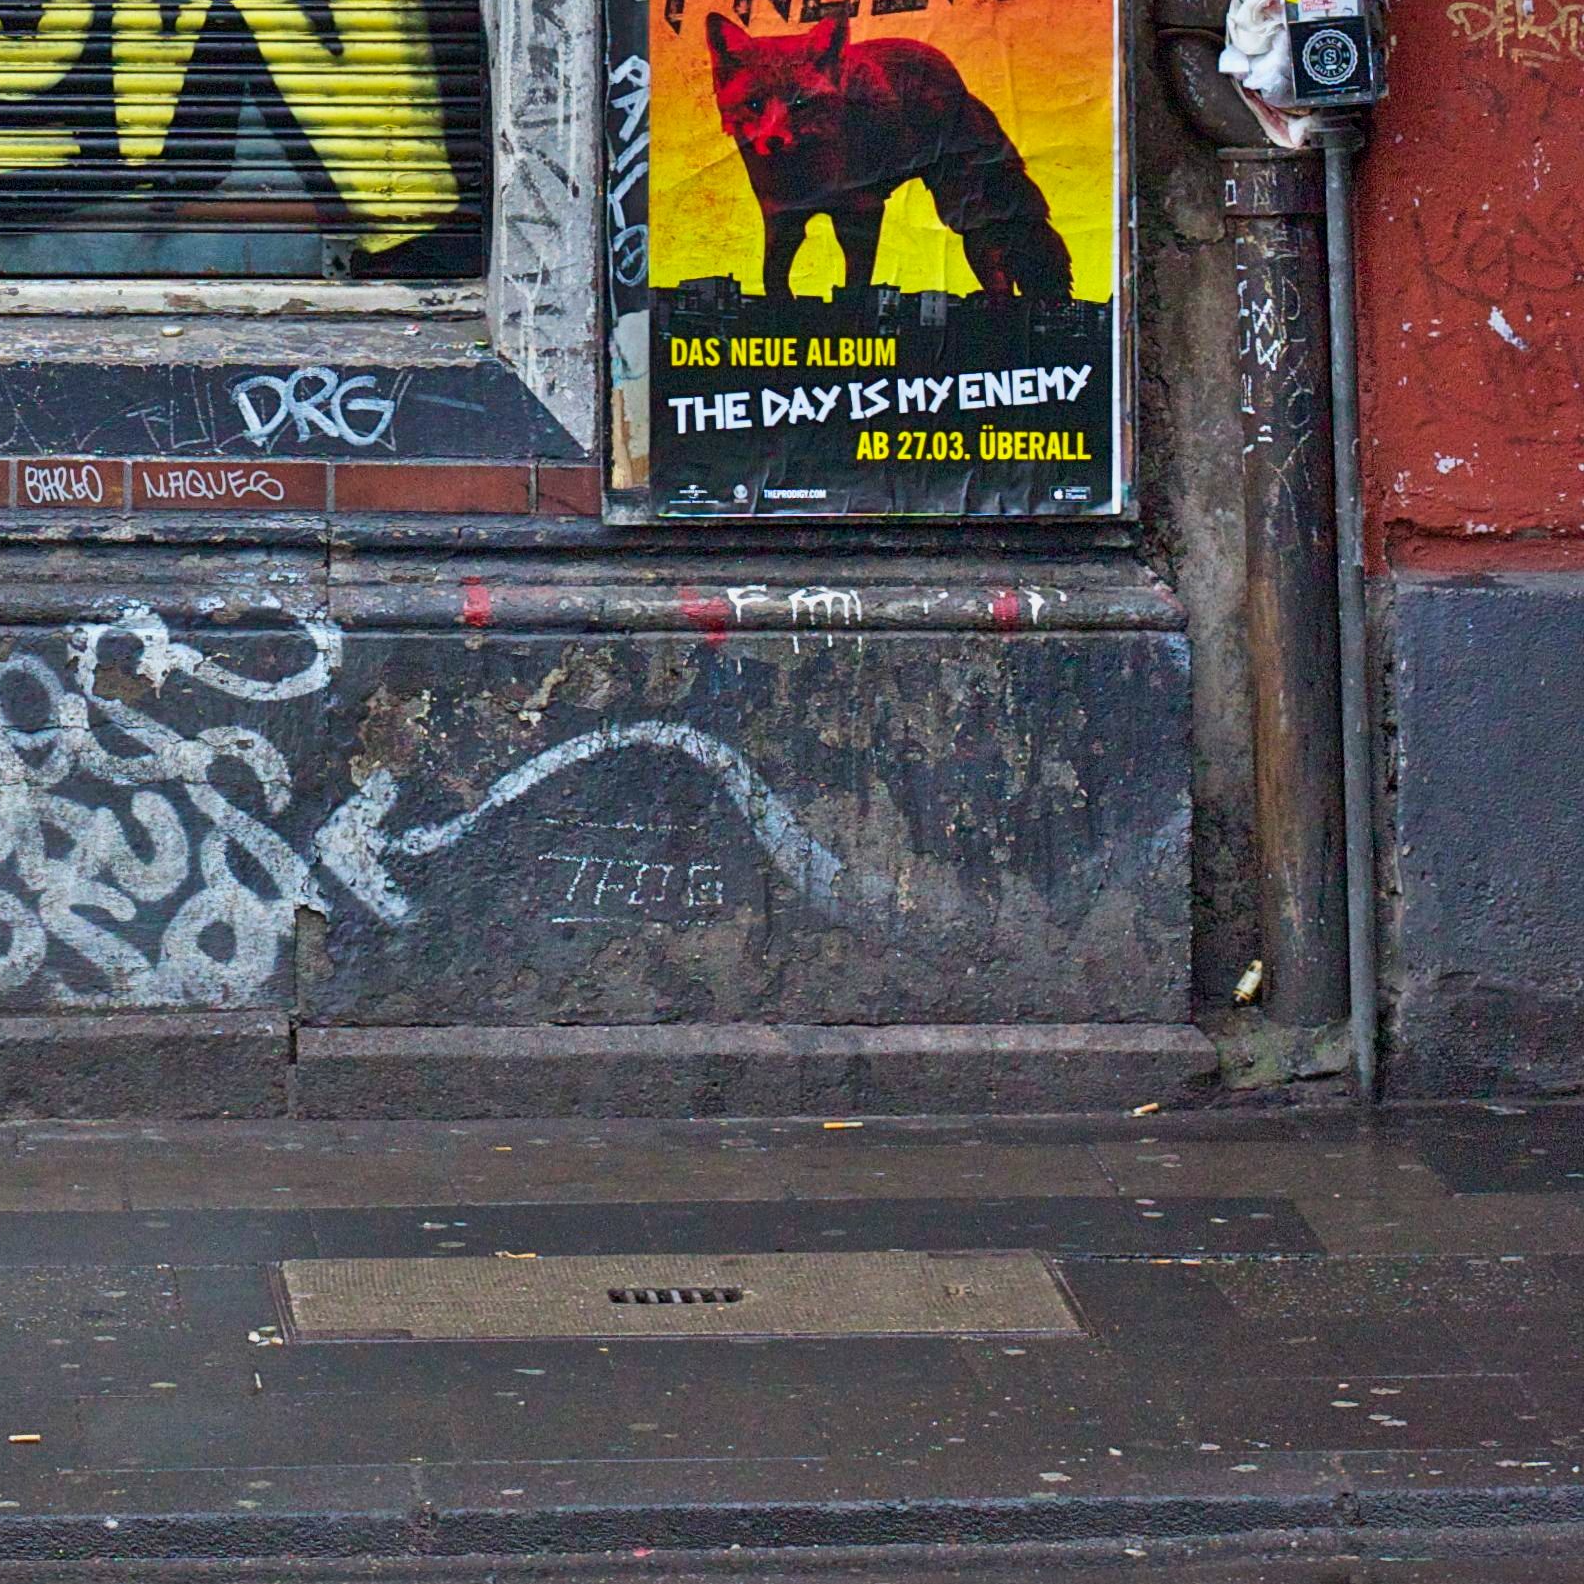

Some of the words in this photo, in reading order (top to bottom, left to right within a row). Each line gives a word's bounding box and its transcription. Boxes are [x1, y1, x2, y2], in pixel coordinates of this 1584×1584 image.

[670, 337, 720, 367] DAS
[730, 337, 798, 367] NEUE
[806, 337, 897, 367] ALBUM
[668, 392, 752, 434] THE
[761, 385, 842, 427] DAY
[848, 378, 890, 420] IS
[898, 375, 954, 414] MY
[959, 364, 1092, 410] ENEMY
[855, 431, 889, 461] AB
[897, 431, 971, 461] 27.03.
[979, 424, 1092, 461] ÜBERALL
[763, 489, 826, 499] THEPRODIGY.COM
